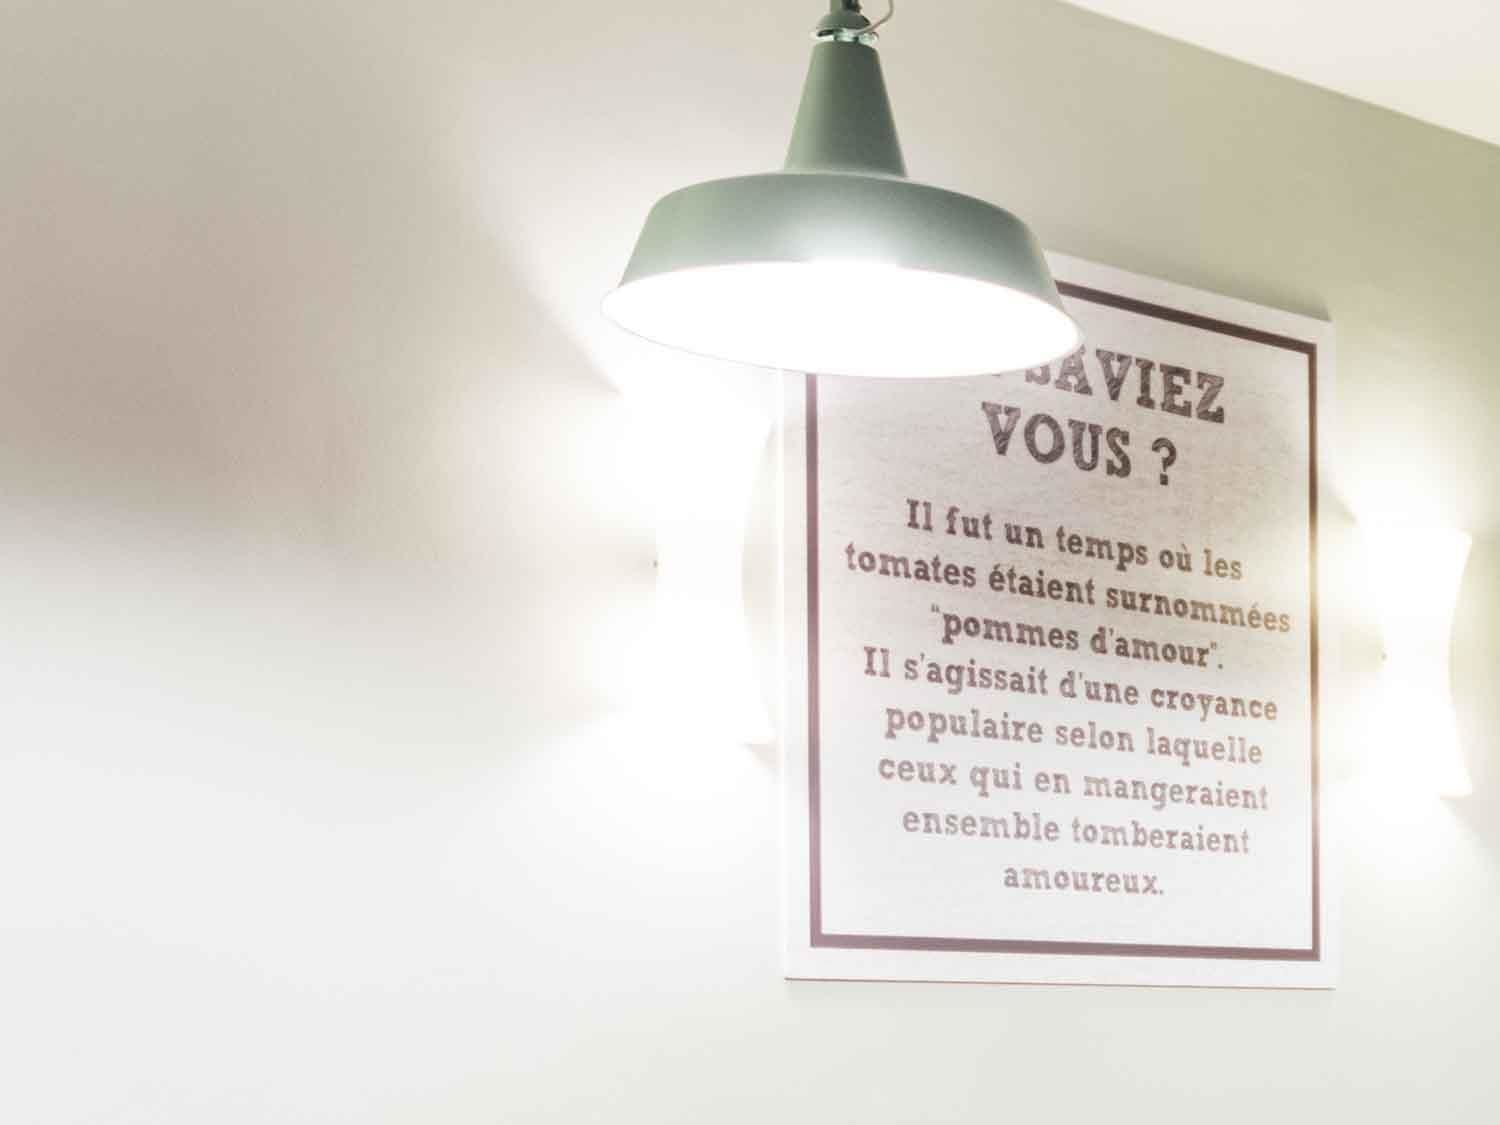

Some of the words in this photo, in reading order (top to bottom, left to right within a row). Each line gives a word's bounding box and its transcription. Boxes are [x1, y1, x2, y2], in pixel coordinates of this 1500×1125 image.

[981, 400, 1131, 478] VOUS
[907, 498, 933, 530] Il
[946, 506, 993, 541] fut
[1005, 521, 1044, 549] un
[1056, 523, 1149, 571] temps
[1159, 541, 1192, 571] où
[1204, 548, 1242, 580] les
[845, 542, 976, 588] tomates
[989, 563, 1095, 606] étaient
[1106, 585, 1290, 632] surnommées
[863, 647, 891, 678] Il
[904, 653, 1048, 697] s'agissait
[1059, 669, 1138, 706] d'une
[1151, 685, 1277, 722] croyance
[885, 706, 1043, 747] populaire
[1055, 719, 1135, 754] selon
[1147, 727, 1262, 766] laquelle
[878, 754, 956, 785] ceux
[969, 760, 1023, 796] qui
[1034, 771, 1071, 795] en
[1083, 773, 1269, 811] mangeraient
[902, 806, 1059, 843] ensemble
[1072, 818, 1250, 854] tomberaient
[1003, 862, 1164, 896] amoureux.
